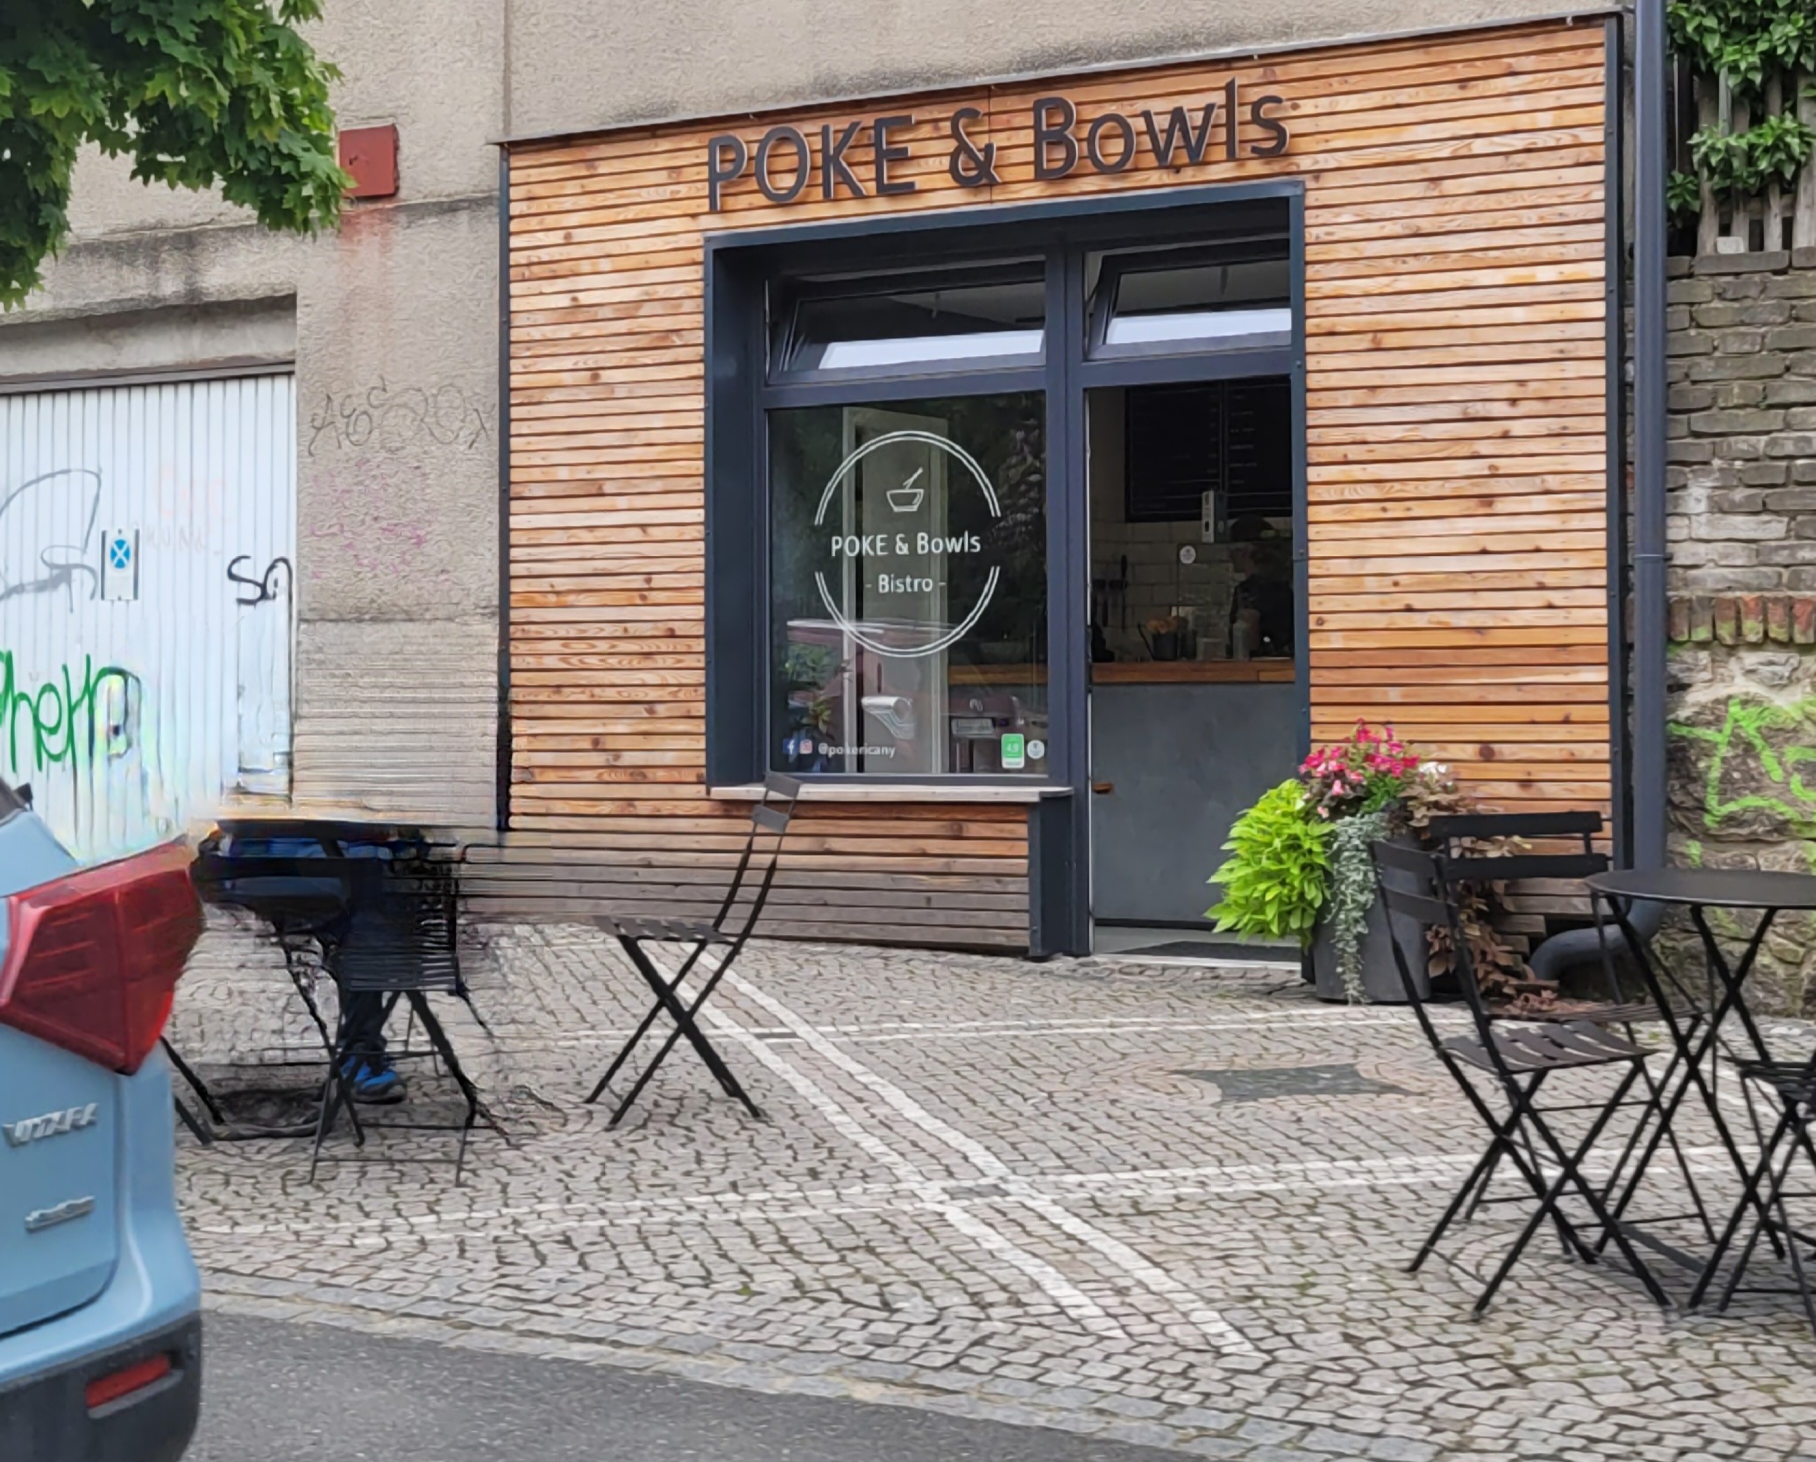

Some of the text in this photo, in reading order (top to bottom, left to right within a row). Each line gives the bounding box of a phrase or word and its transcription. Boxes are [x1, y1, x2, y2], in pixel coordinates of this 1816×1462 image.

[707, 76, 1291, 212] POKE & Bowls
[831, 530, 981, 557] POKE & Bowls
[878, 573, 933, 594] Bistro
